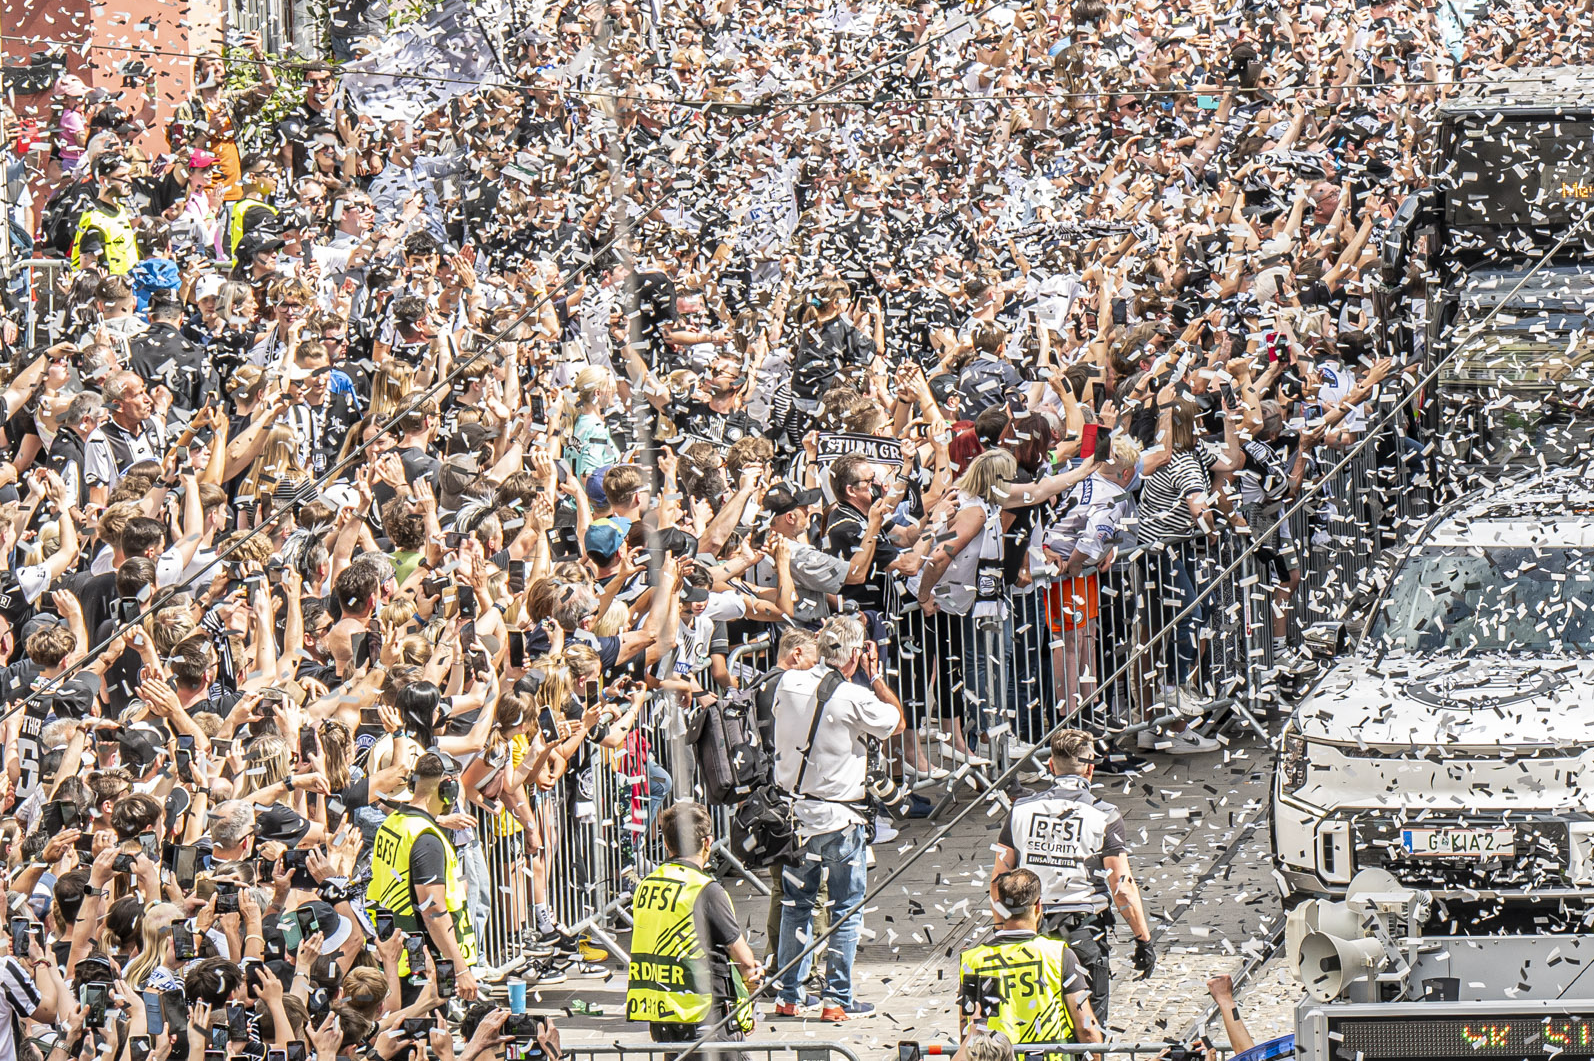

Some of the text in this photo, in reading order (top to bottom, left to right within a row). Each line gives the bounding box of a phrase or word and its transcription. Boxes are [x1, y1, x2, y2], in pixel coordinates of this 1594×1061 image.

[826, 438, 904, 460] STURM GR
[1036, 820, 1074, 842] BFS
[376, 834, 395, 866] BFS
[1027, 840, 1079, 854] SECURITY
[637, 885, 673, 911] BFS
